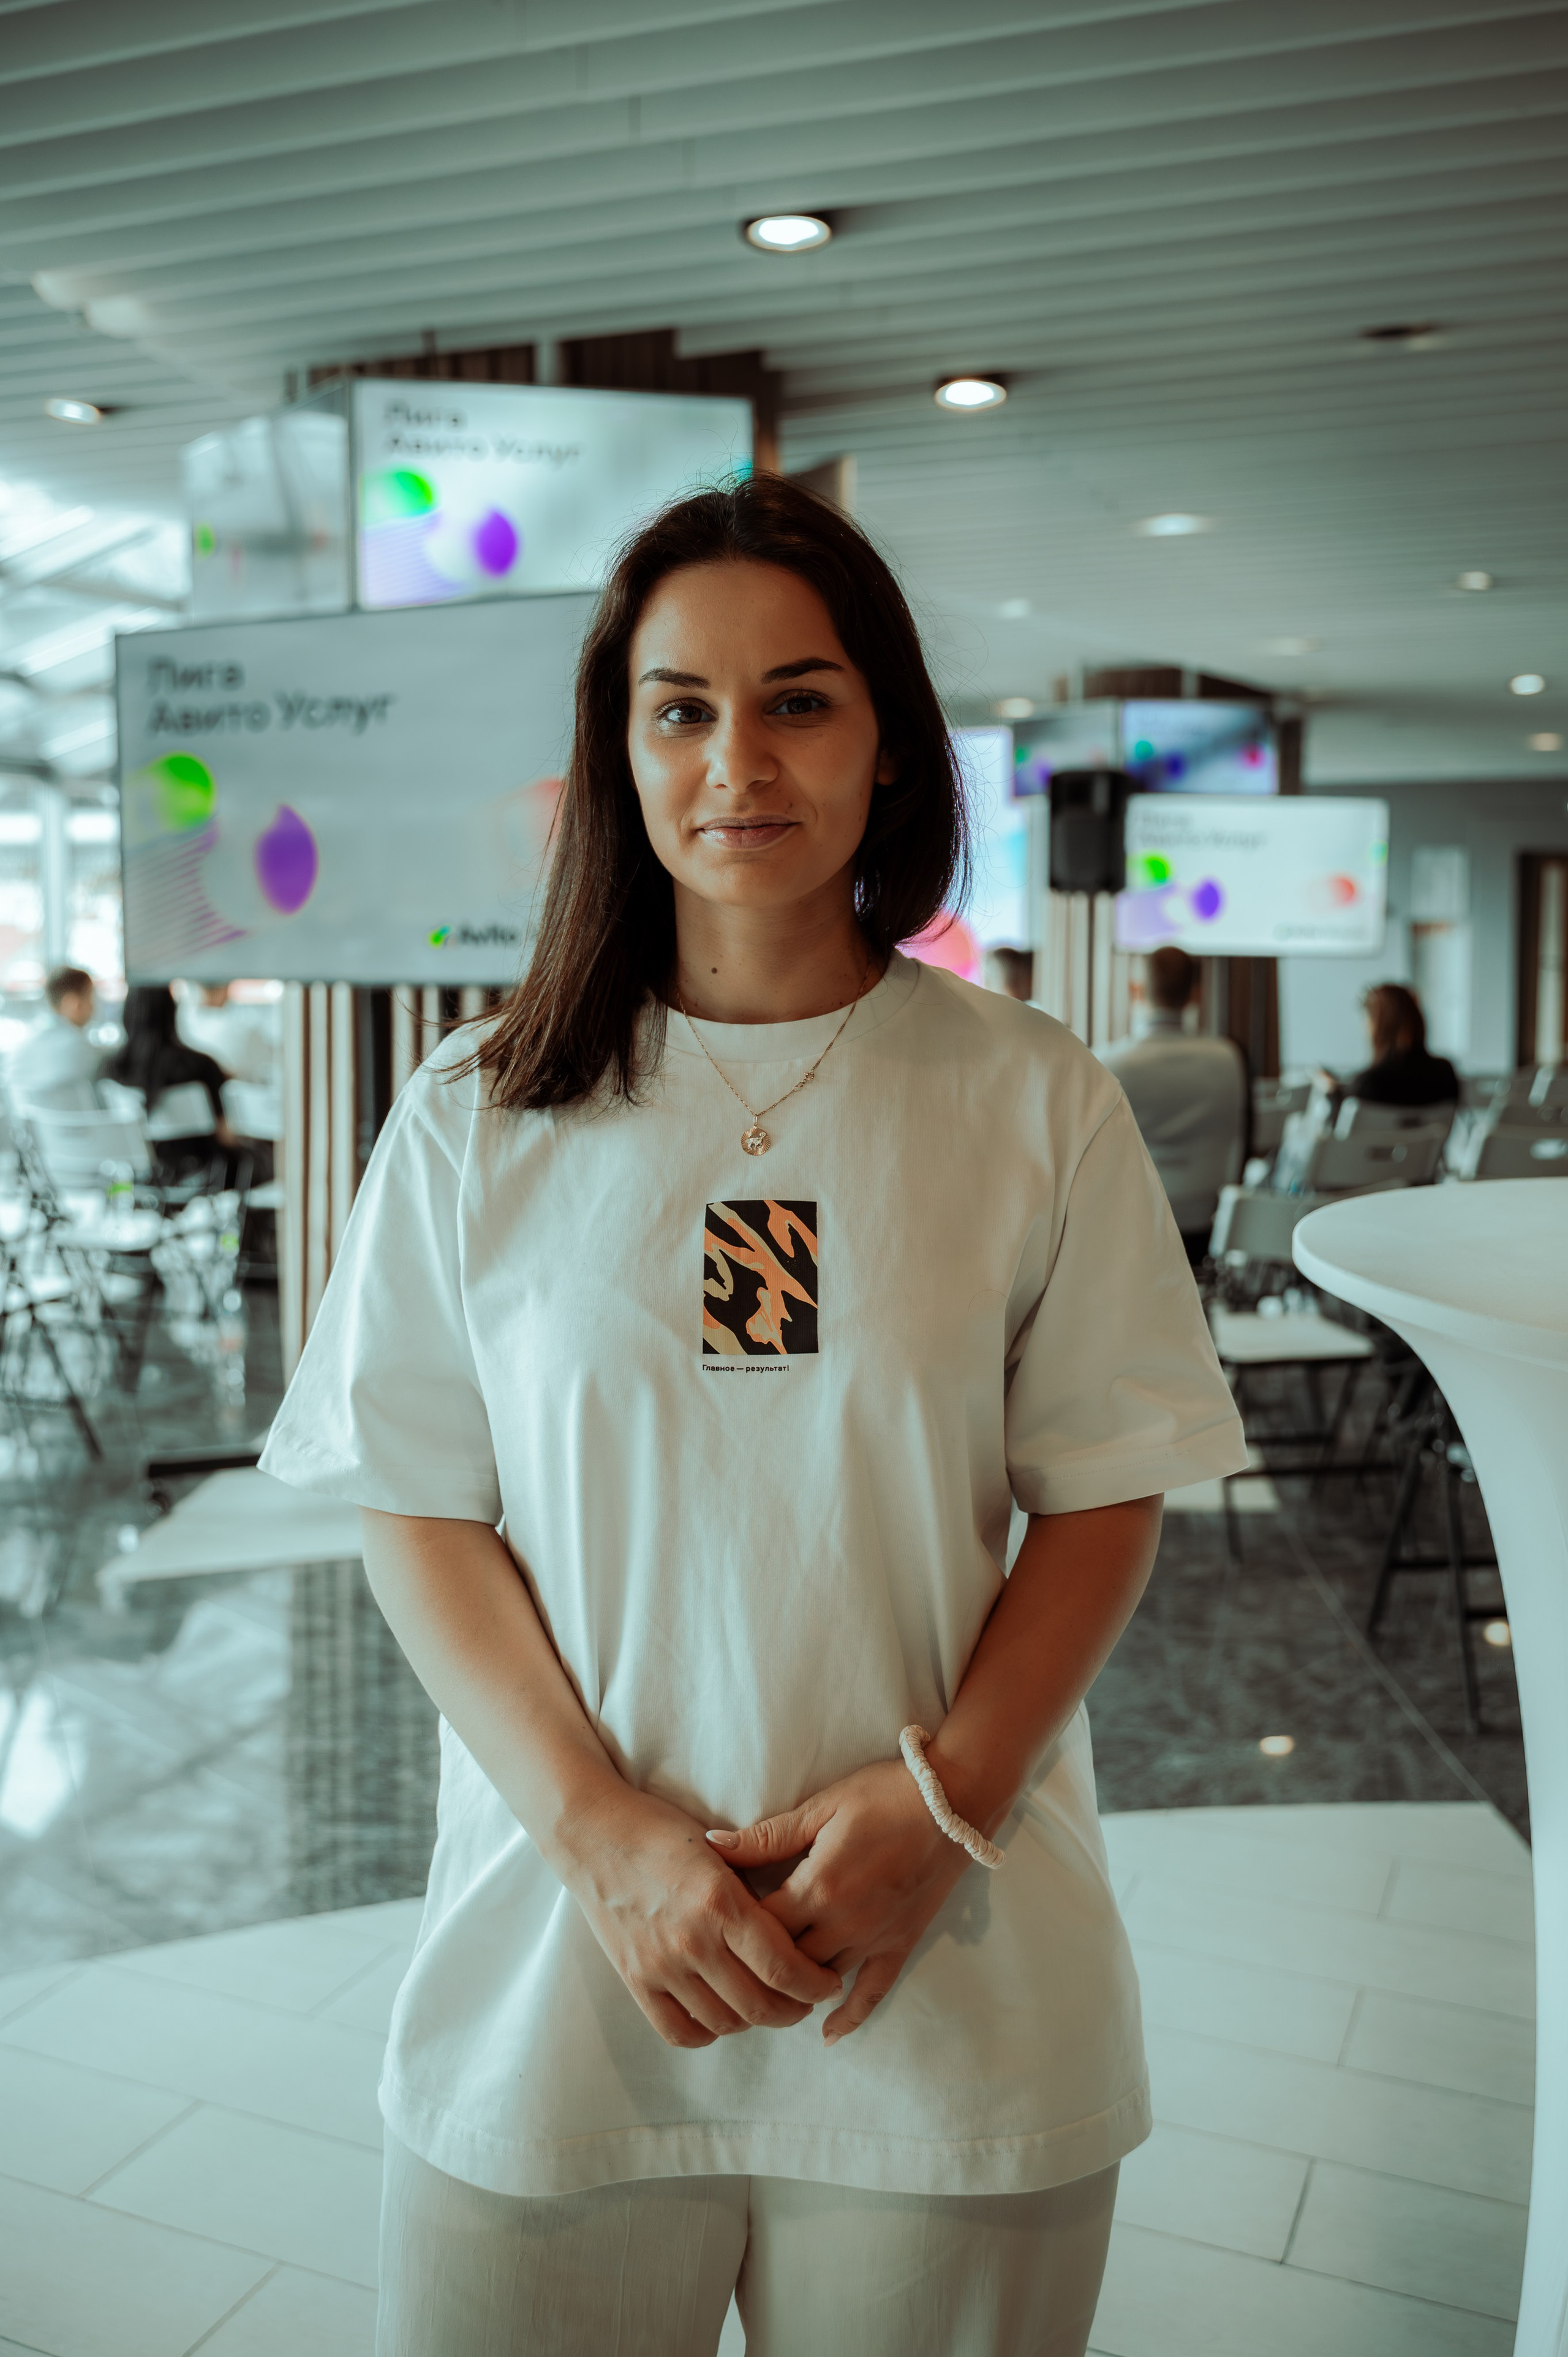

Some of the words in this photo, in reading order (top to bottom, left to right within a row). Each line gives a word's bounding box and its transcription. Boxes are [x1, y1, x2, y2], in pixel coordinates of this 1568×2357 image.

[146, 655, 245, 695] Лига
[146, 700, 272, 737] Авито
[274, 690, 396, 737] Услуг
[745, 1364, 790, 1373] результат!
